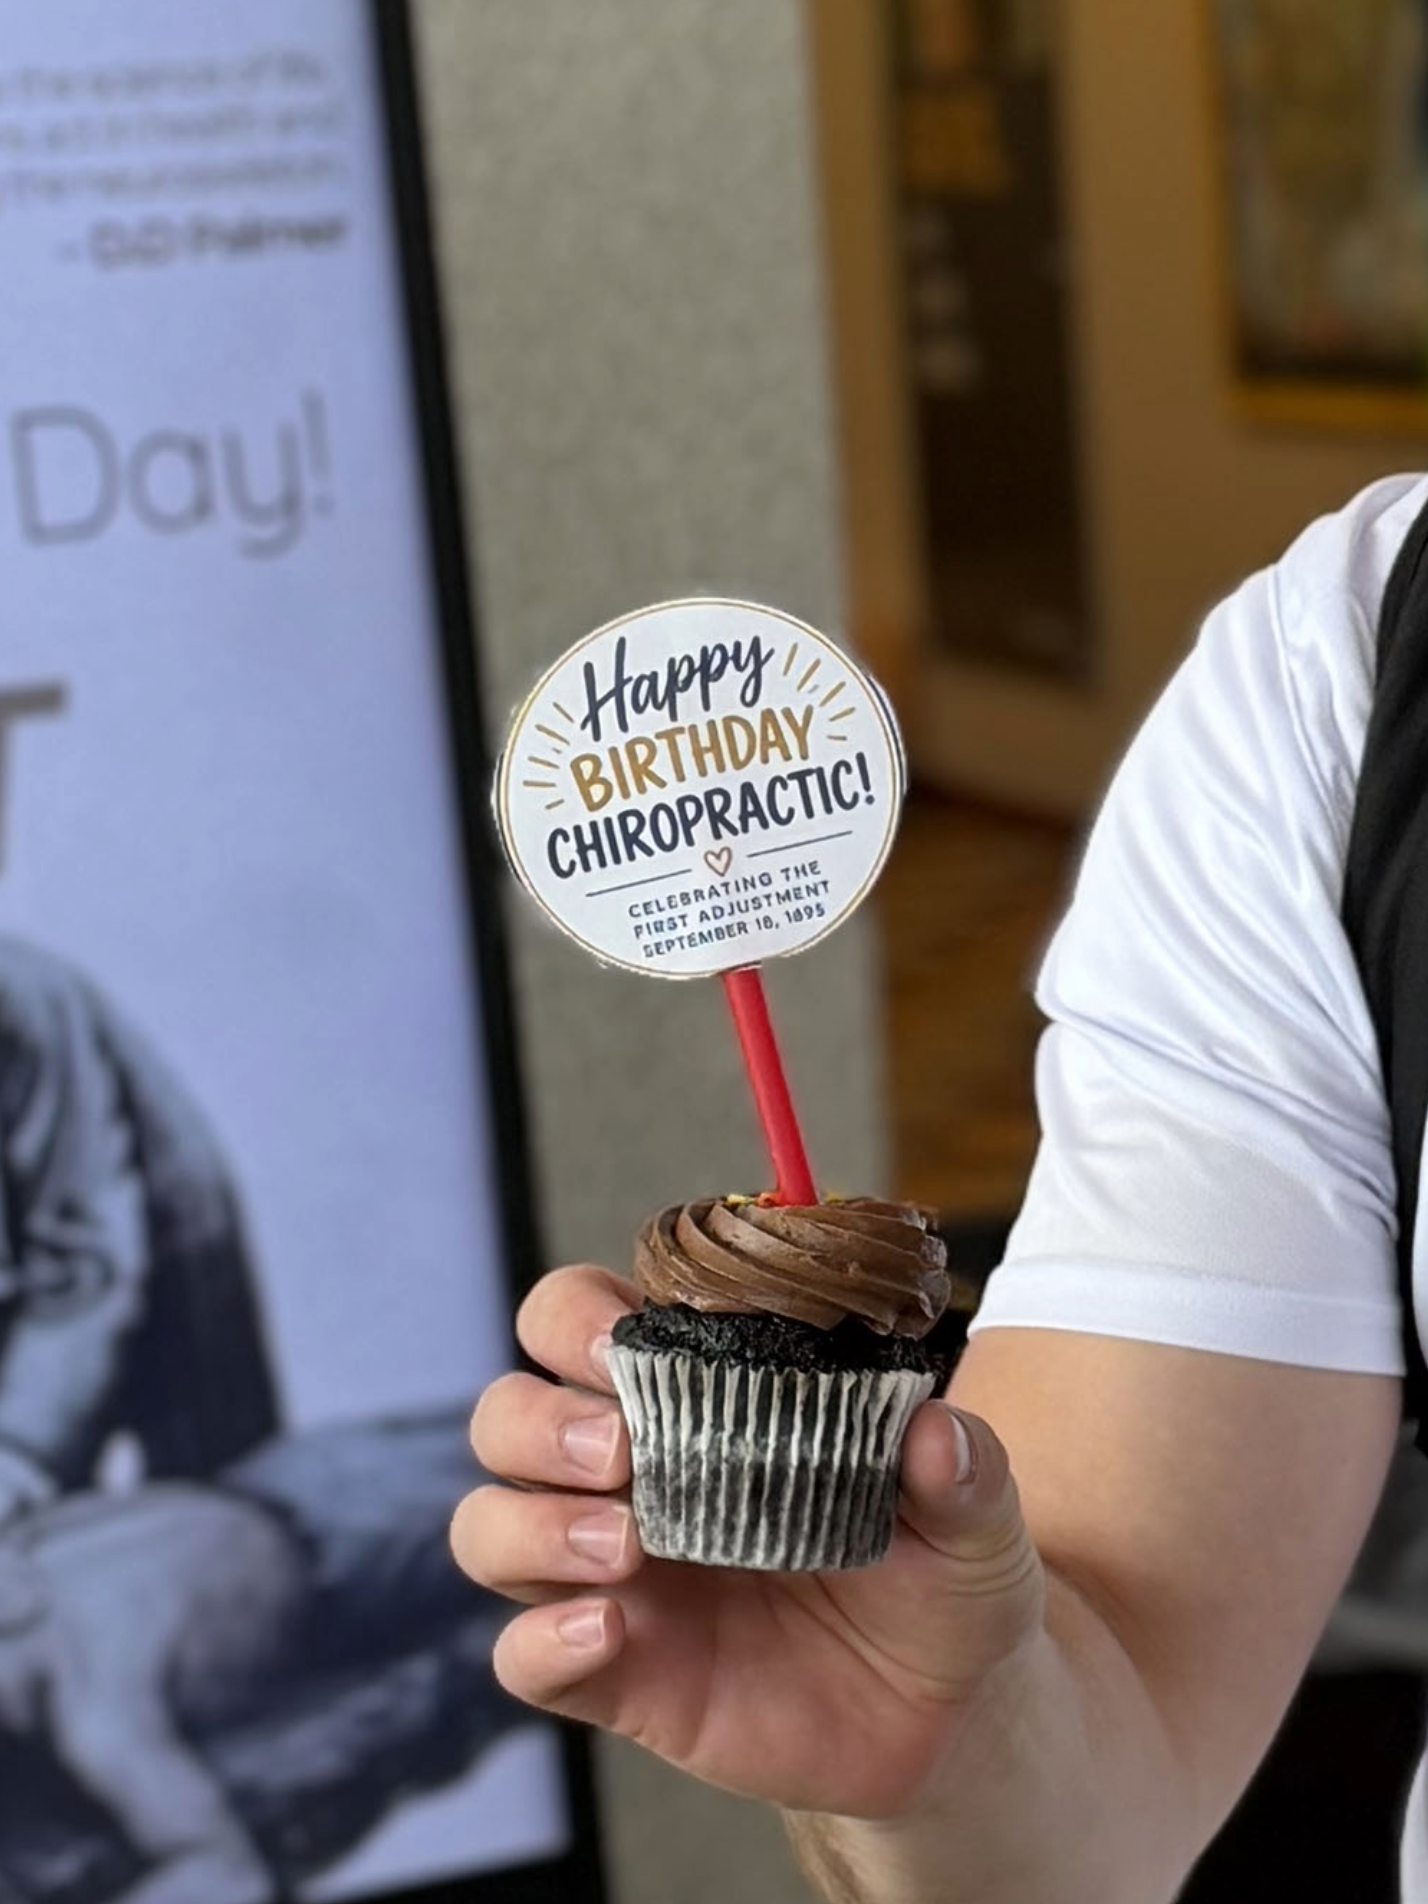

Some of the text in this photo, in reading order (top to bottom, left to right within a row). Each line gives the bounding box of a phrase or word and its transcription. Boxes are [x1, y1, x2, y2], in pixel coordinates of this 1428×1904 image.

[9, 384, 337, 562] Day!
[580, 635, 775, 742] Happy
[569, 703, 815, 813] BIRTHDAY
[546, 751, 876, 880] CHIROPRACTIC!
[628, 860, 822, 919] CELEBRATING THE
[633, 879, 831, 940] FIRST ADJUSTMENT
[642, 919, 749, 959] SEPTEMBER
[784, 902, 827, 924] 1895
